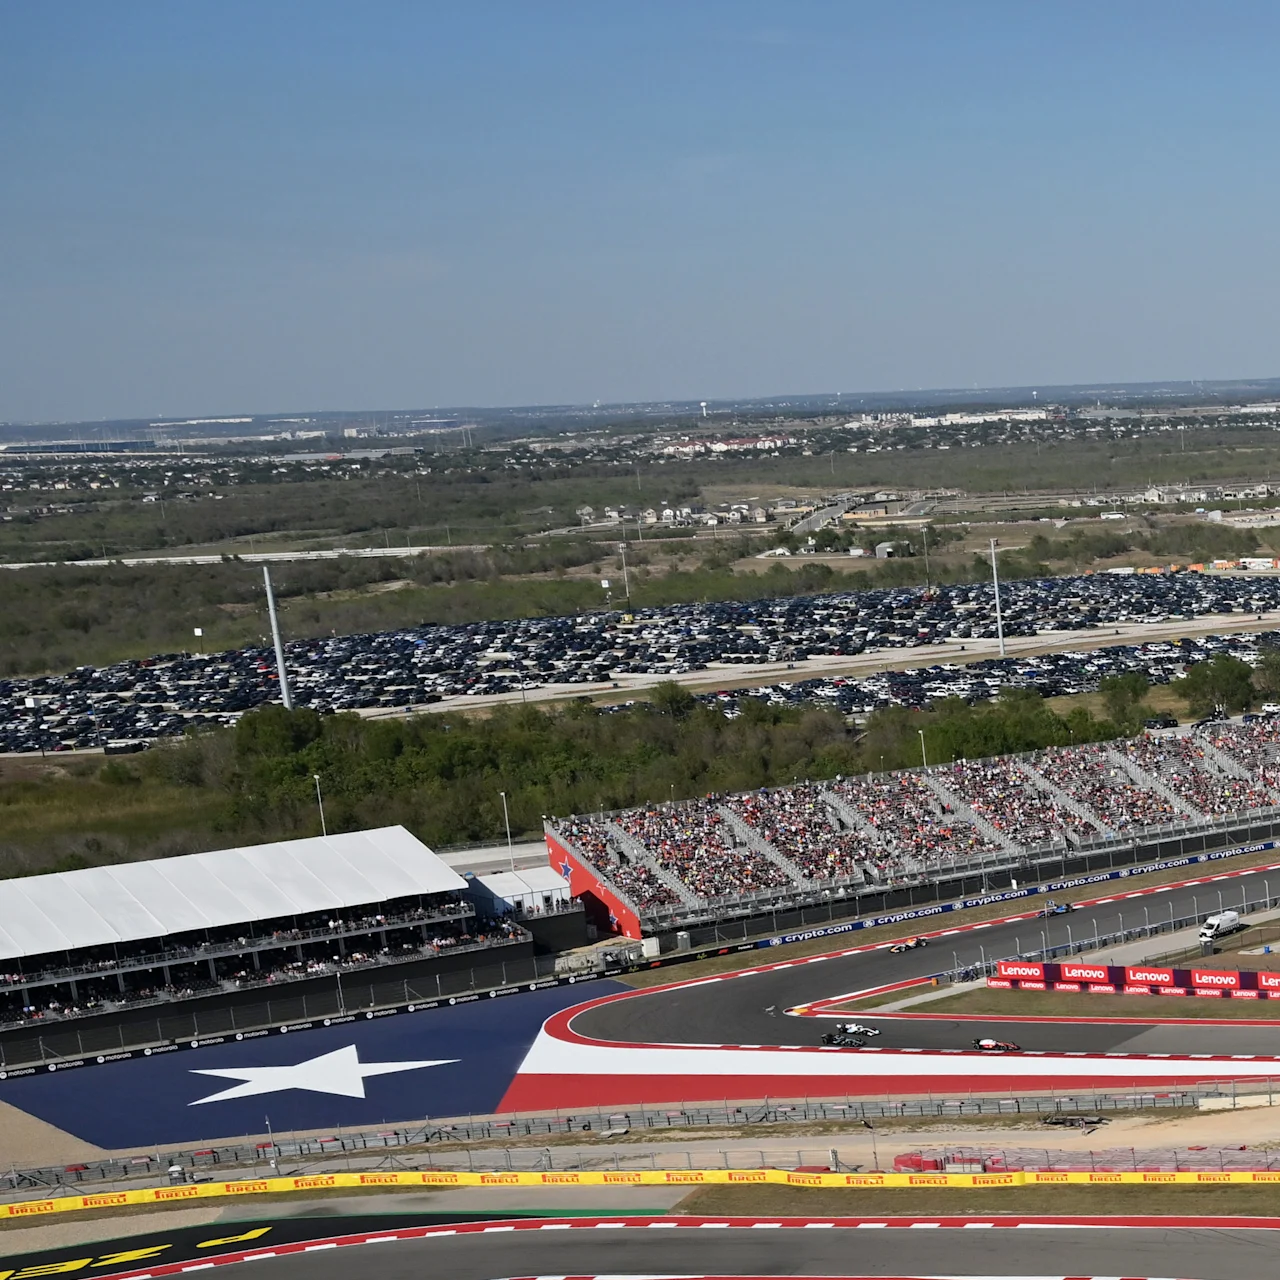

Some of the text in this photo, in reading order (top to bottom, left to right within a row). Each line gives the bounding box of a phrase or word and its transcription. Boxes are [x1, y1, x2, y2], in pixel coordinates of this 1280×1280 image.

[1211, 843, 1264, 860] crypto.com
[1132, 858, 1189, 875] crypto.com
[966, 889, 1028, 906] crypto.com
[878, 906, 942, 925] crypto.com
[786, 923, 853, 942] crypto.com
[1002, 966, 1040, 975] Lenovo
[1065, 967, 1104, 978] Lenovo
[1130, 971, 1169, 981] Lenovo
[1196, 974, 1235, 984] Lenovo
[199, 1037, 224, 1046] motorola
[152, 1044, 178, 1054] motorola
[105, 1052, 131, 1061] motorola
[8, 1068, 35, 1077] motorola
[294, 1176, 335, 1188] PIRELLI
[604, 1174, 641, 1183] PIRELLI
[972, 1175, 1013, 1185] PIRELLI
[1143, 1173, 1176, 1182] PIRELLI
[226, 1182, 267, 1193] PIRELLI
[83, 1194, 126, 1206] PIRELLI
[9, 1202, 54, 1215] PIRELLI
